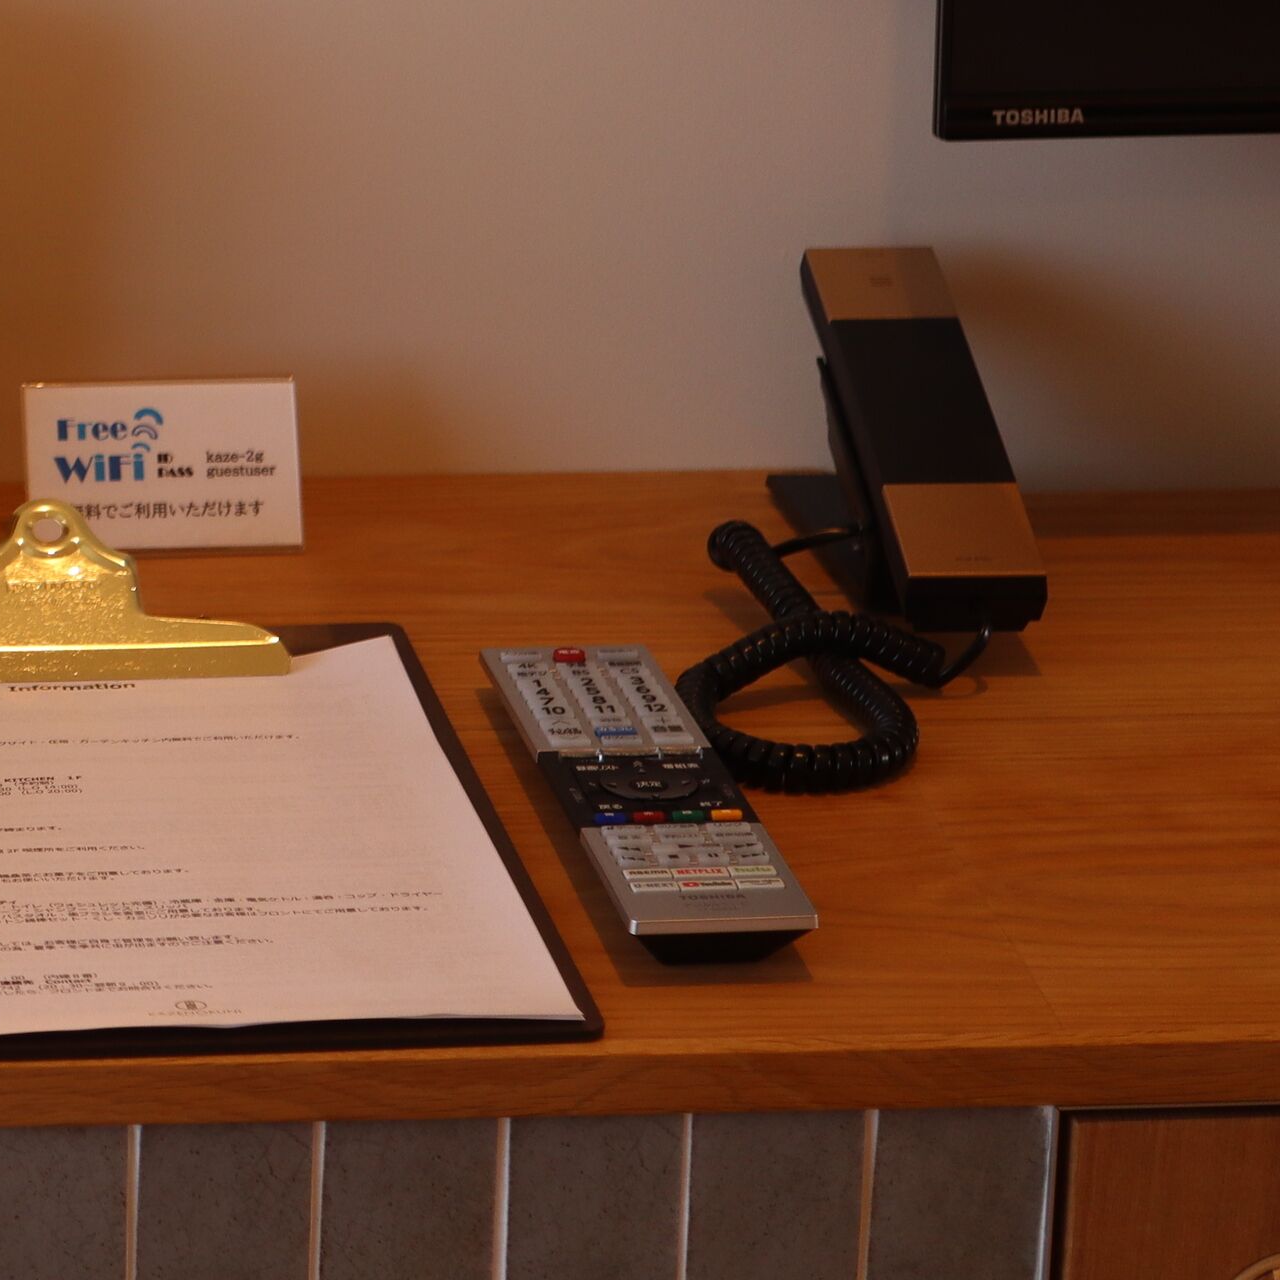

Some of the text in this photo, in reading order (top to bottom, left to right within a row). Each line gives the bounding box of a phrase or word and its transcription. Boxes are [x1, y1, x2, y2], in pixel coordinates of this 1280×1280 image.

[992, 108, 1085, 126] TOSHIBA
[56, 418, 128, 442] Free
[206, 449, 264, 465] kaze-2g
[54, 453, 146, 484] WiFi
[206, 465, 276, 480] guestuser
[8, 682, 137, 692] Information
[541, 703, 668, 716] 10 11 12
[676, 867, 723, 875] NETFLIX
